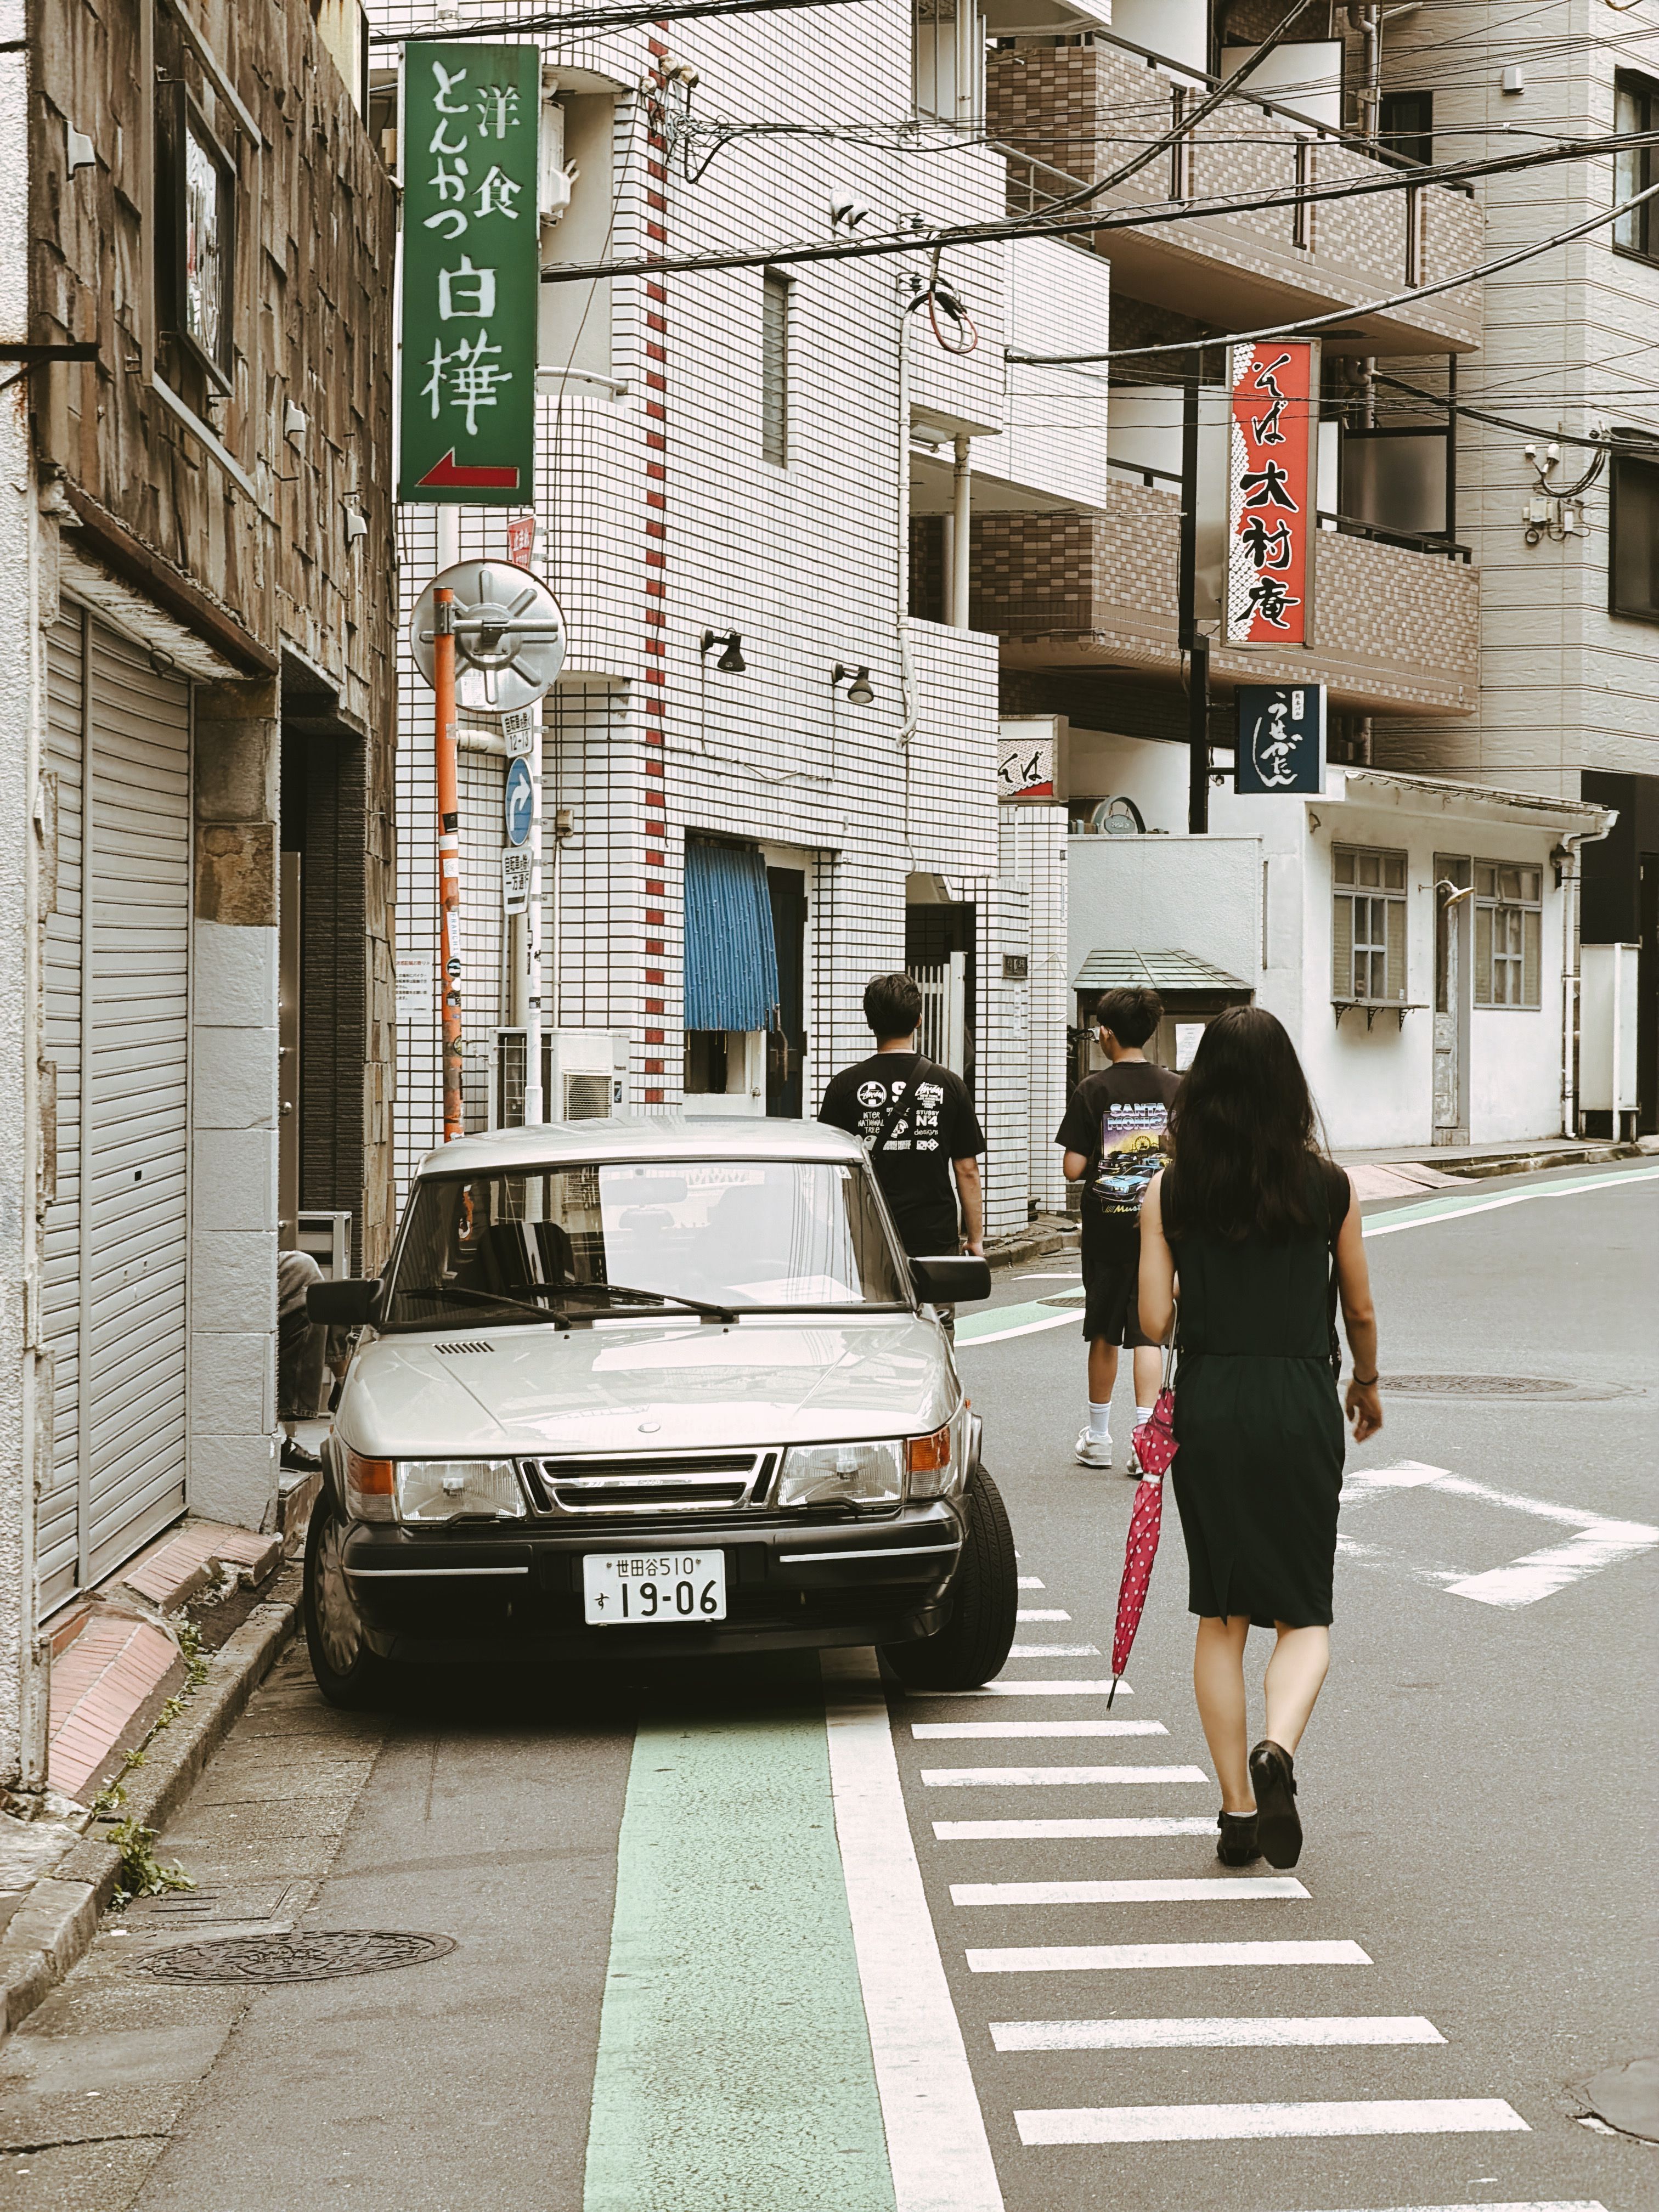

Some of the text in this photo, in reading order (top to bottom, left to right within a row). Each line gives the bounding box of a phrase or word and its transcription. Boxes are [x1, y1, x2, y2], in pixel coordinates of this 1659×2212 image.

[423, 60, 469, 240] とんかつ
[472, 84, 522, 219] 洋食
[420, 253, 513, 436] 白樺
[1235, 353, 1301, 630] そば 大村庵
[510, 730, 529, 751] 12-13
[1110, 1103, 1168, 1117] SANTA
[594, 1579, 717, 1618] す 19-06
